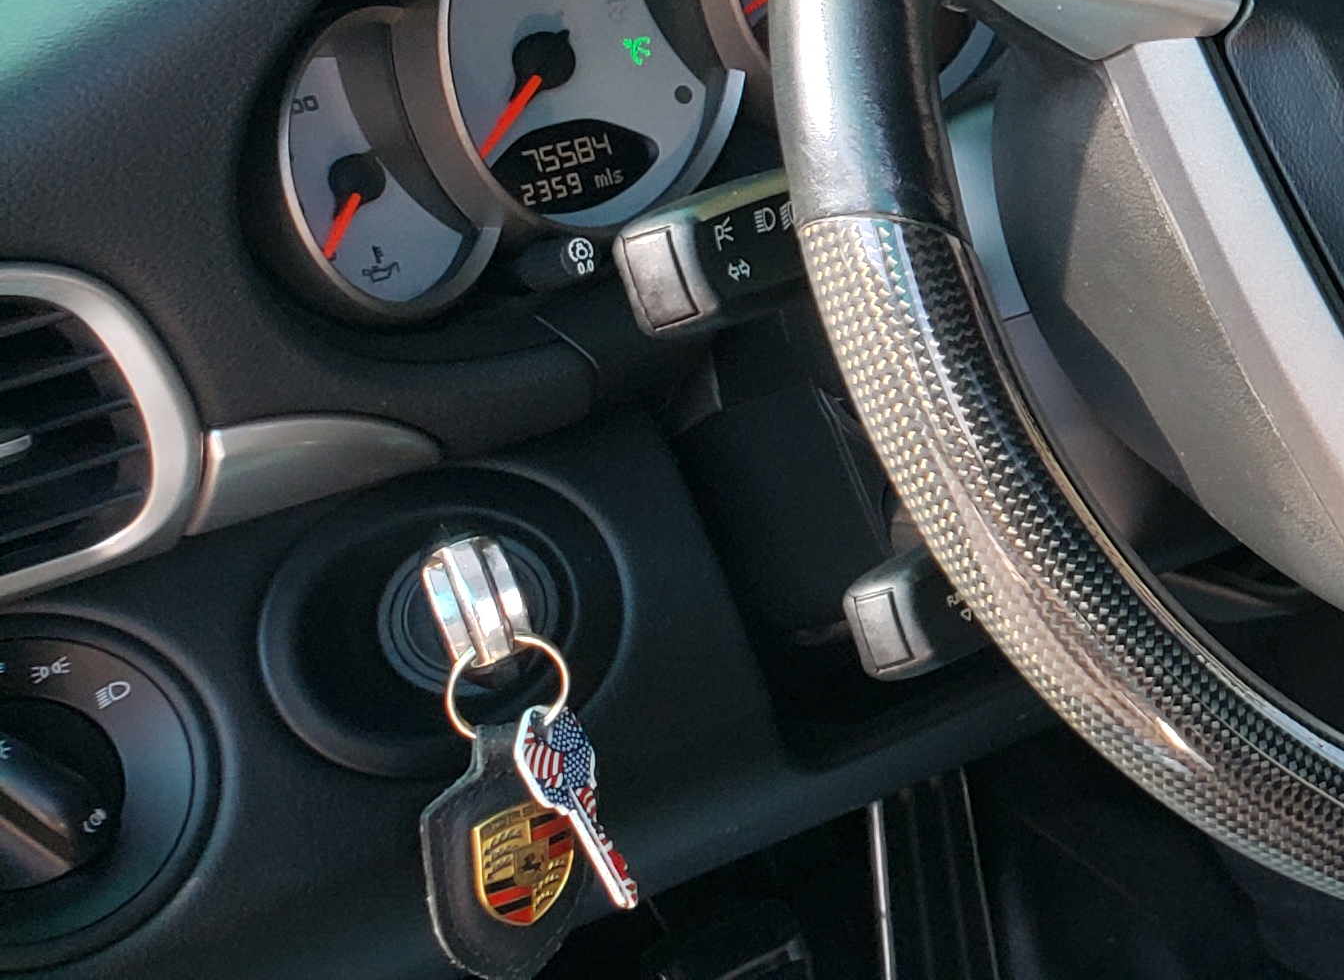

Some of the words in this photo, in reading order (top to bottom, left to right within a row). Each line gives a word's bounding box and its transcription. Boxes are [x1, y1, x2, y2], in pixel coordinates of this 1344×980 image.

[521, 132, 612, 173] 75584
[520, 172, 583, 207] 2359
[594, 167, 624, 188] mls
[577, 259, 595, 275] 0.0
[480, 803, 539, 840] PORS
